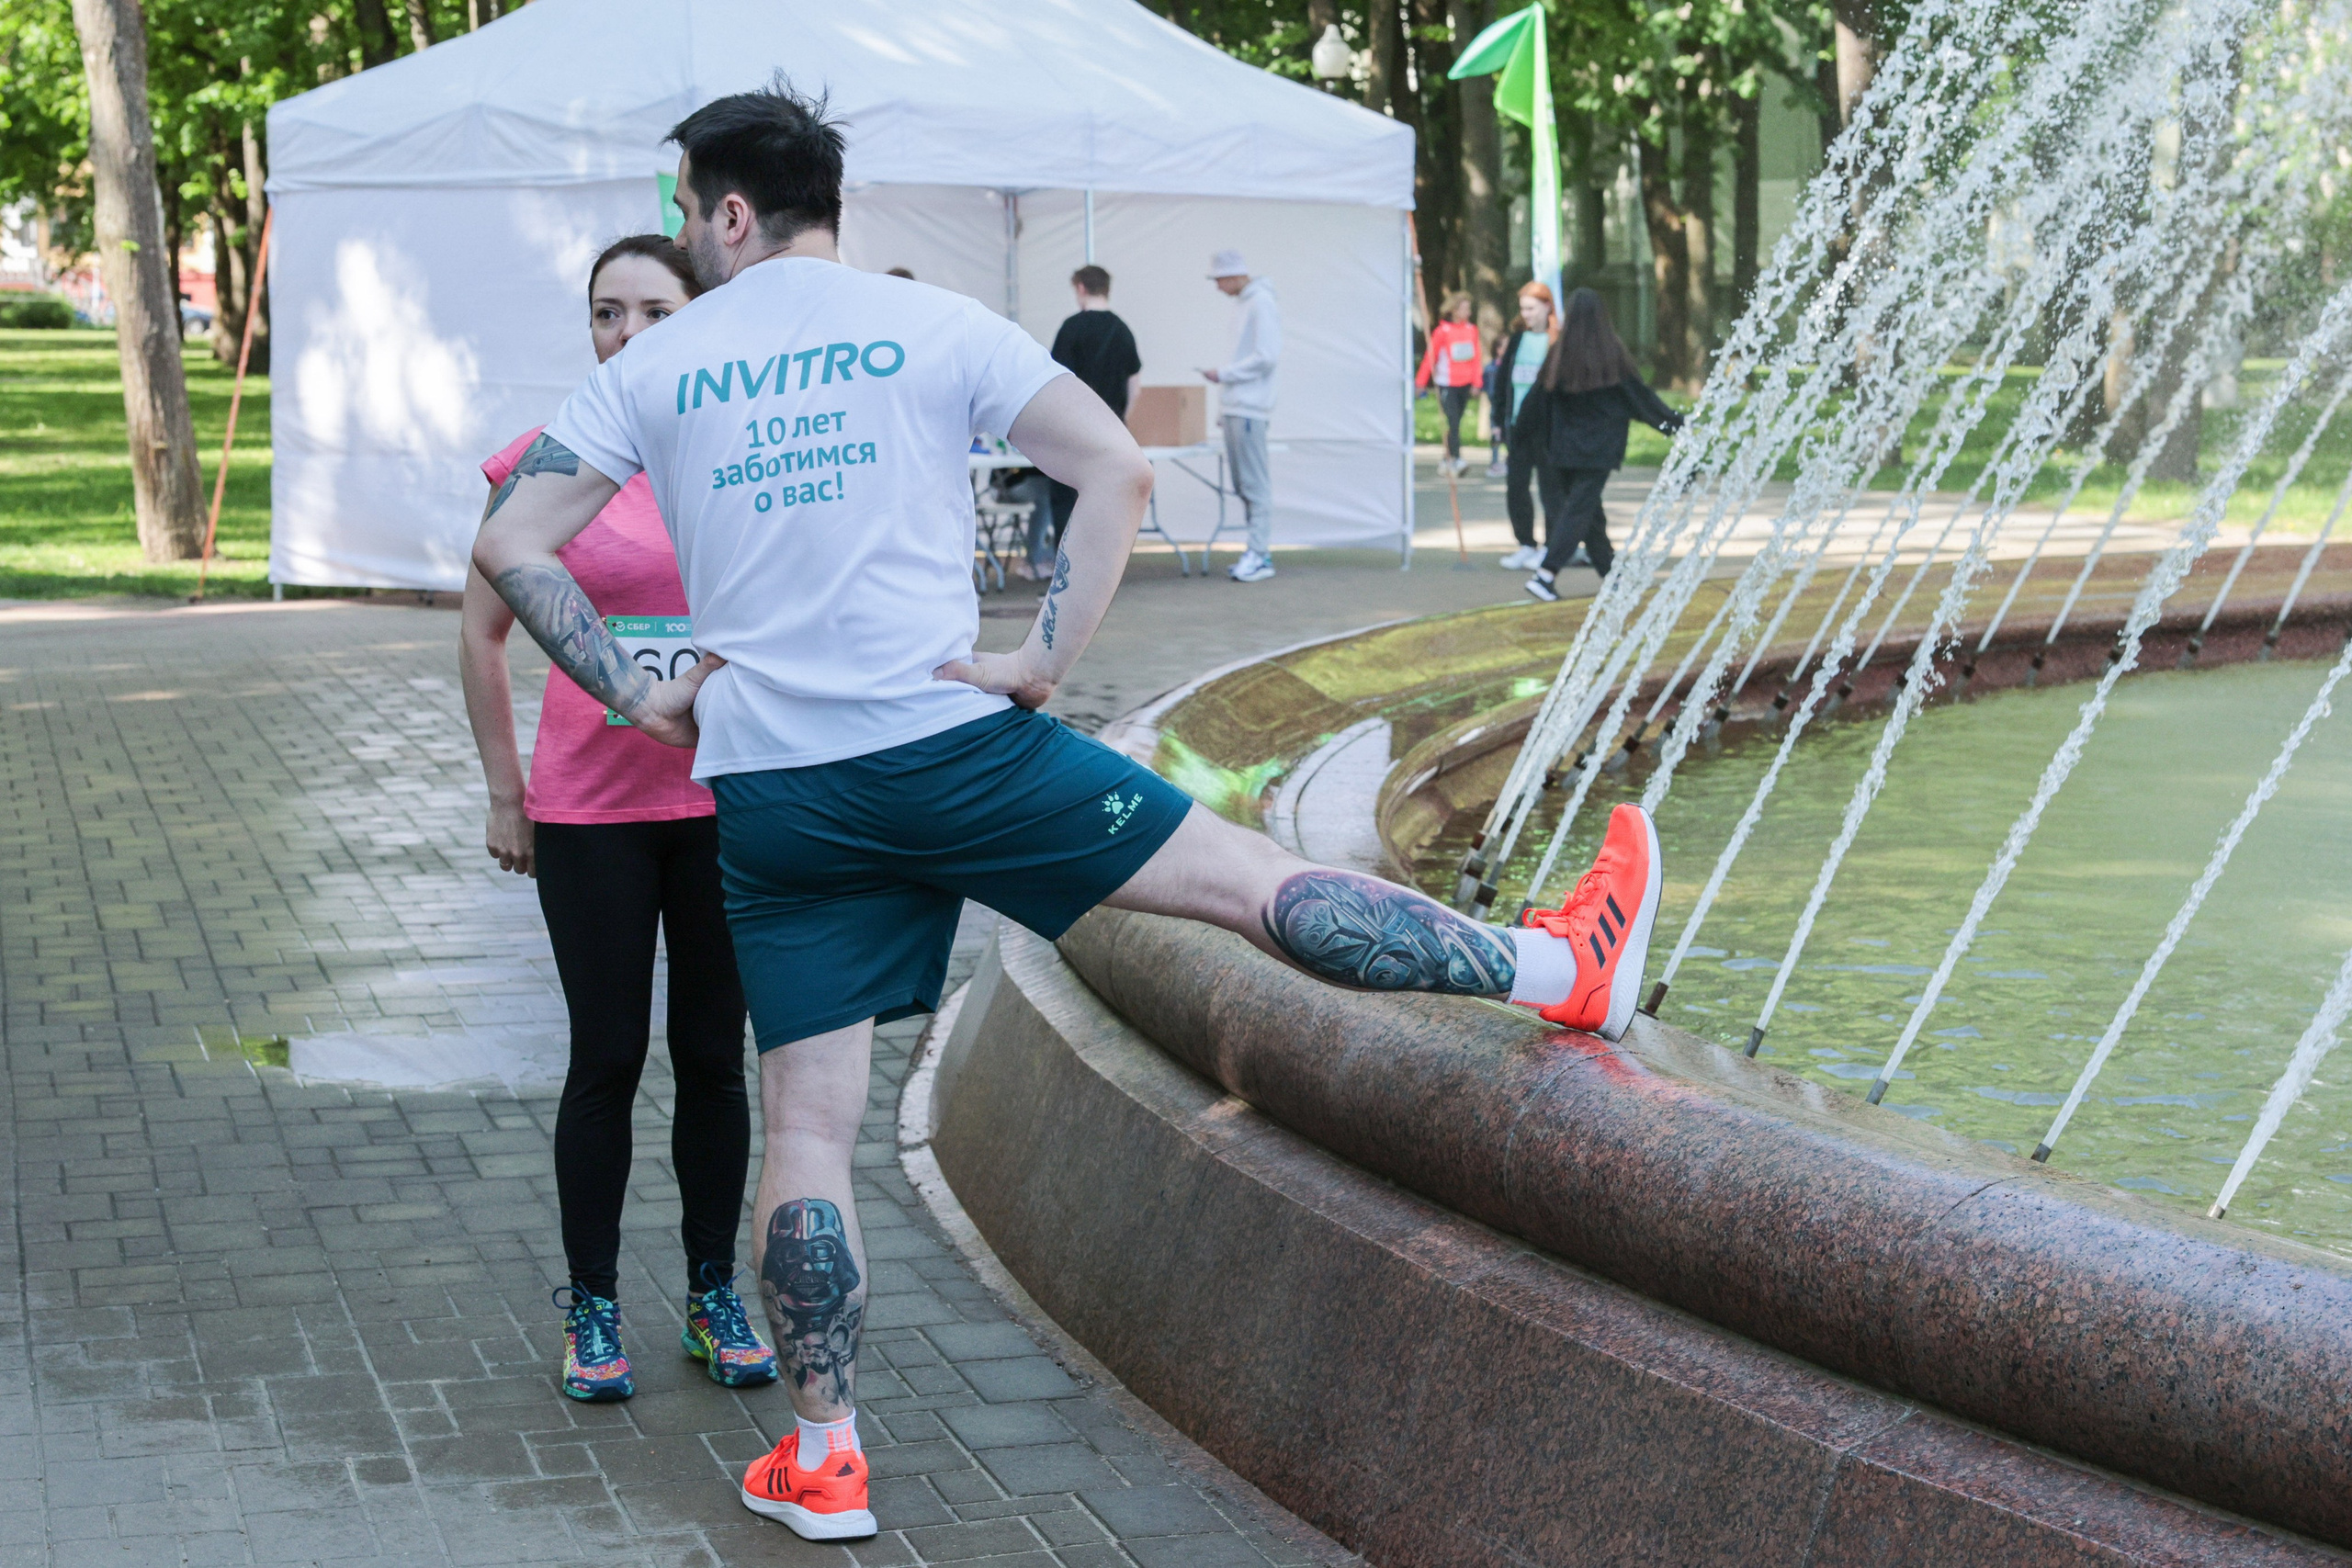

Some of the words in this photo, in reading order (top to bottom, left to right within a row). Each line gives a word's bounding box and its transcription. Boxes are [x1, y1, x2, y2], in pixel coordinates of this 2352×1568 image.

[677, 341, 906, 418] INVITRO
[745, 416, 786, 449] 10
[792, 411, 847, 439] лет
[711, 441, 877, 491] заботимся
[753, 491, 774, 513] о
[782, 470, 845, 508] вас!
[627, 623, 651, 631] СБЕР
[1107, 793, 1144, 835] KELME
